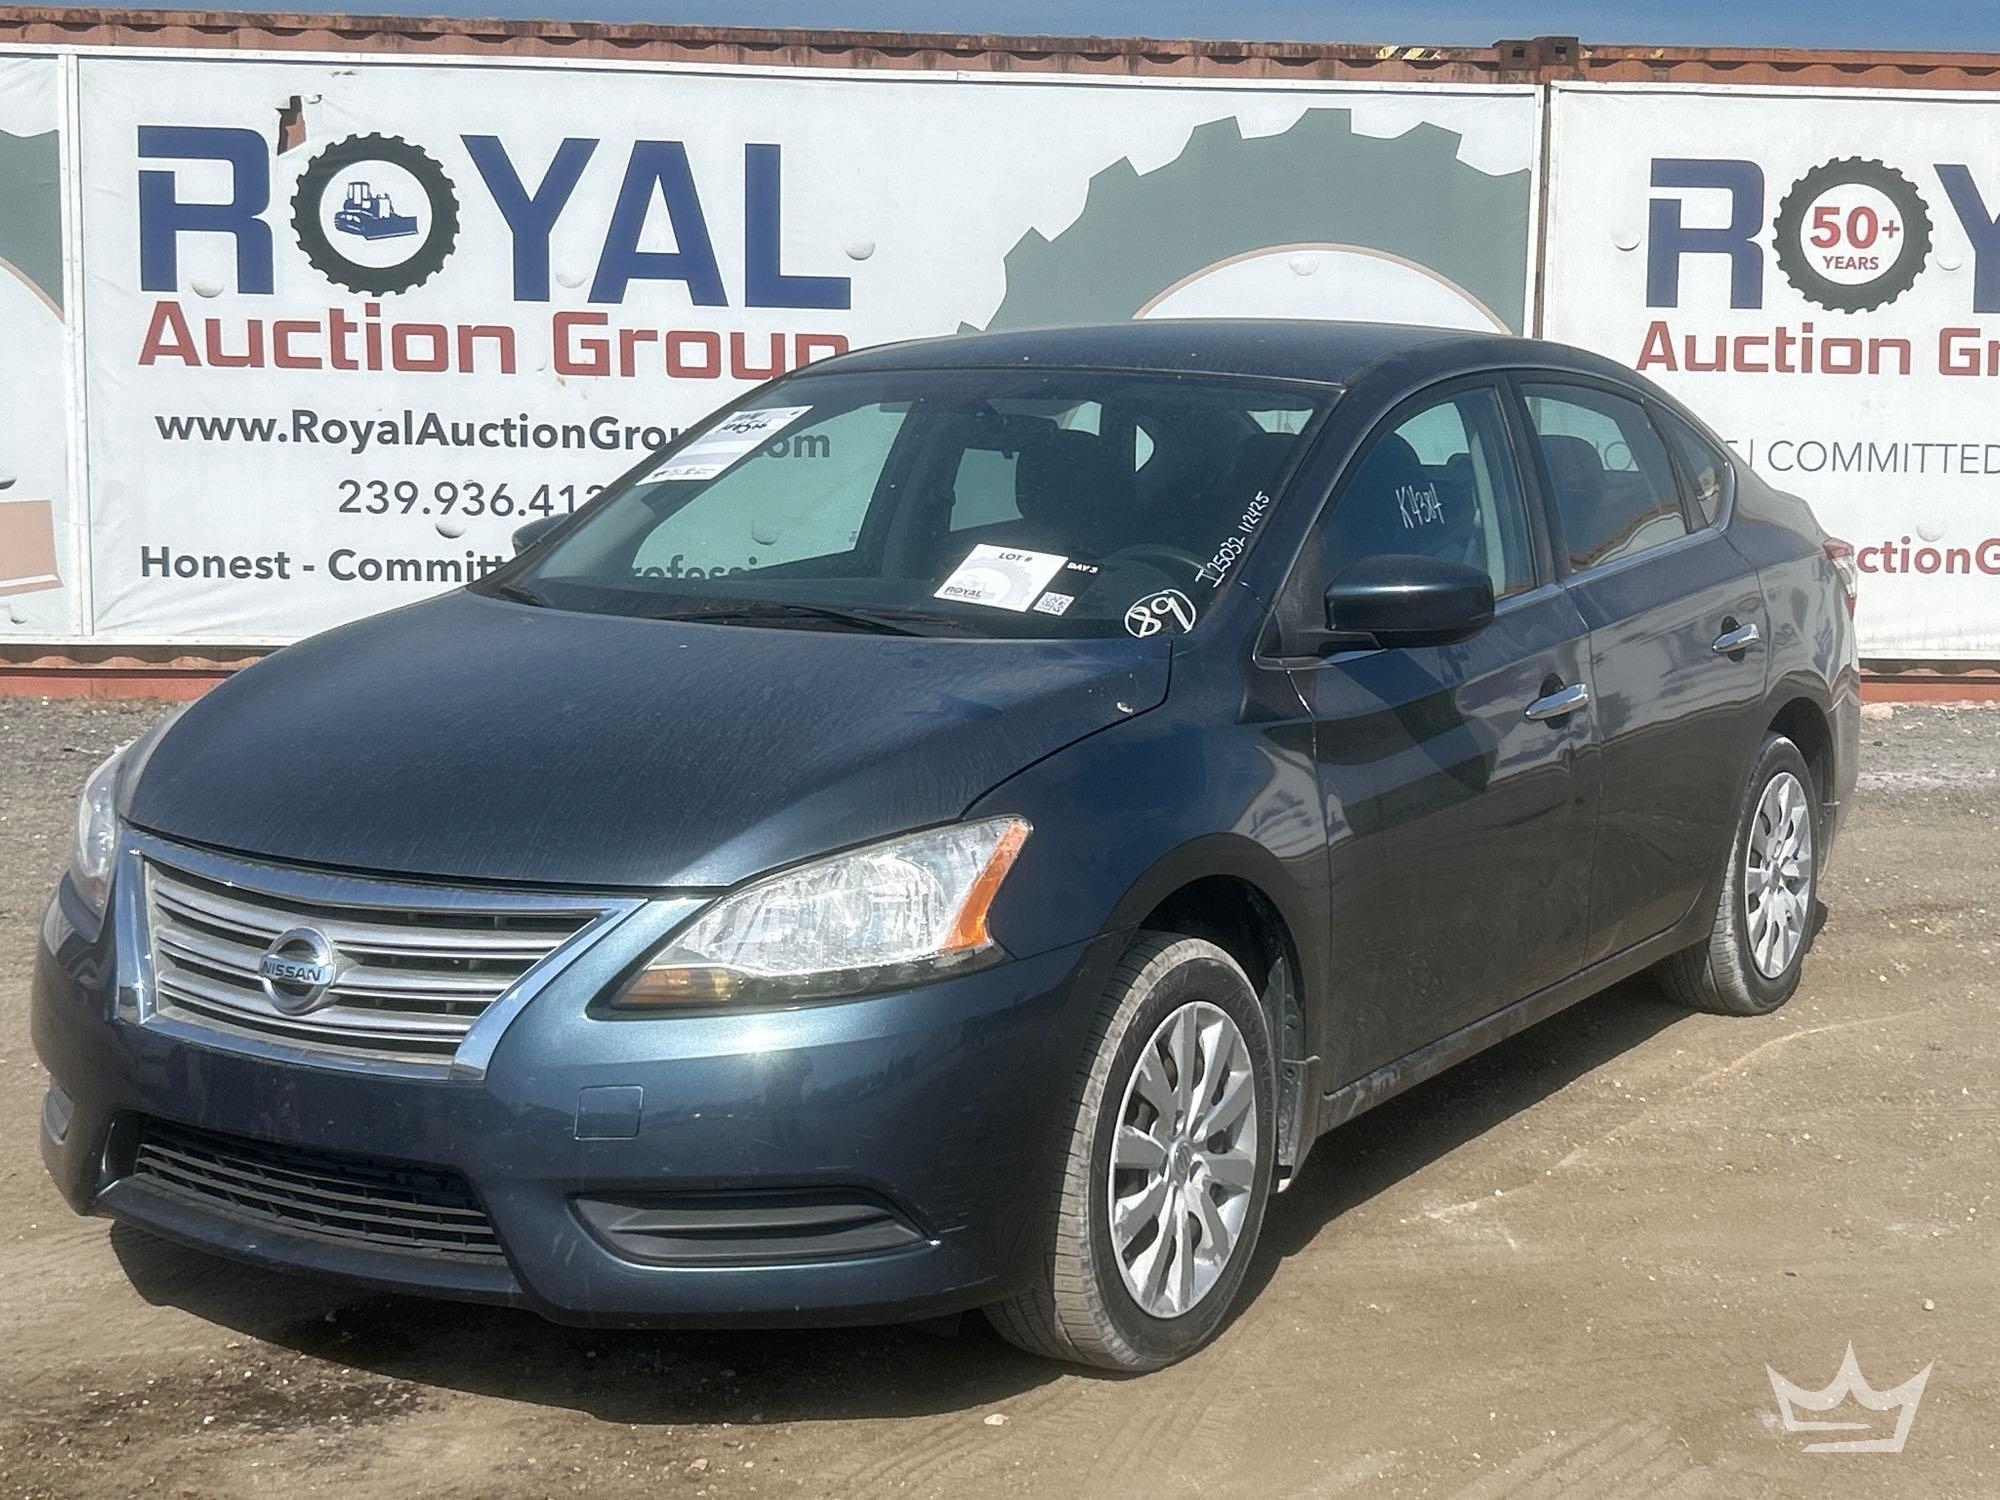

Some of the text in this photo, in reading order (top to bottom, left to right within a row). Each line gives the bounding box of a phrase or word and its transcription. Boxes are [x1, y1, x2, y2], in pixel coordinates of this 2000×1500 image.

[138, 125, 851, 310] ROYAL
[1810, 205, 1900, 249] 50+
[1823, 255, 1879, 271] YEARS
[138, 301, 516, 375] Auction
[1636, 320, 1911, 375] Auction
[141, 546, 290, 580] Honest
[998, 552, 1023, 562] LOT
[1067, 562, 1090, 572] DAY
[1129, 597, 1193, 636] 89
[262, 961, 322, 981] NISSAN
